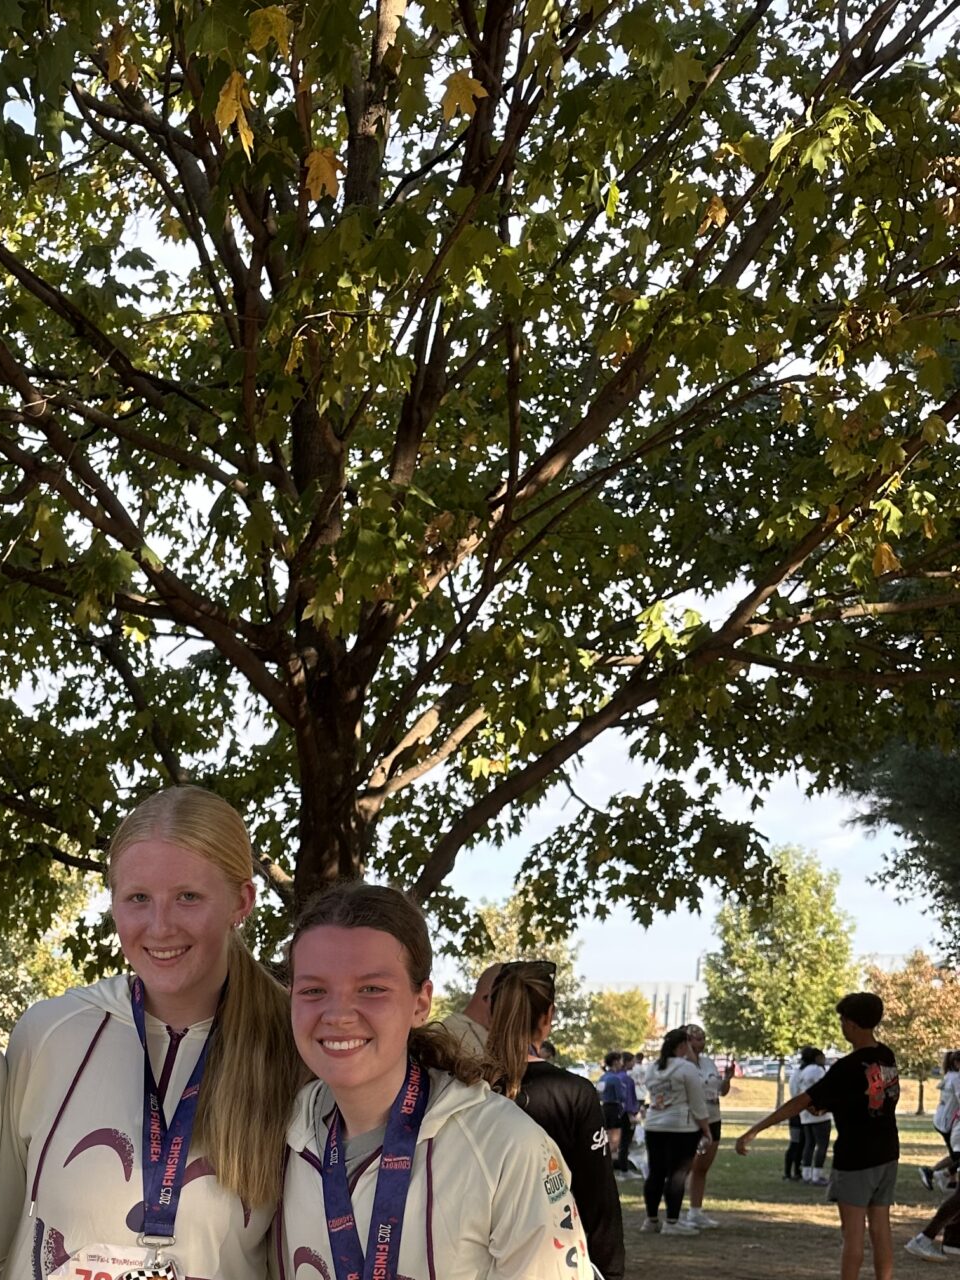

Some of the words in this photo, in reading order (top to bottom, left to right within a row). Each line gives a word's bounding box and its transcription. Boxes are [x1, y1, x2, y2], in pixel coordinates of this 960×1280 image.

[401, 1062, 420, 1115] FINISHER
[150, 1111, 162, 1162] FINISHER
[162, 1136, 184, 1188] FINISHER
[159, 1187, 172, 1205] 2025
[378, 1223, 392, 1243] 2025
